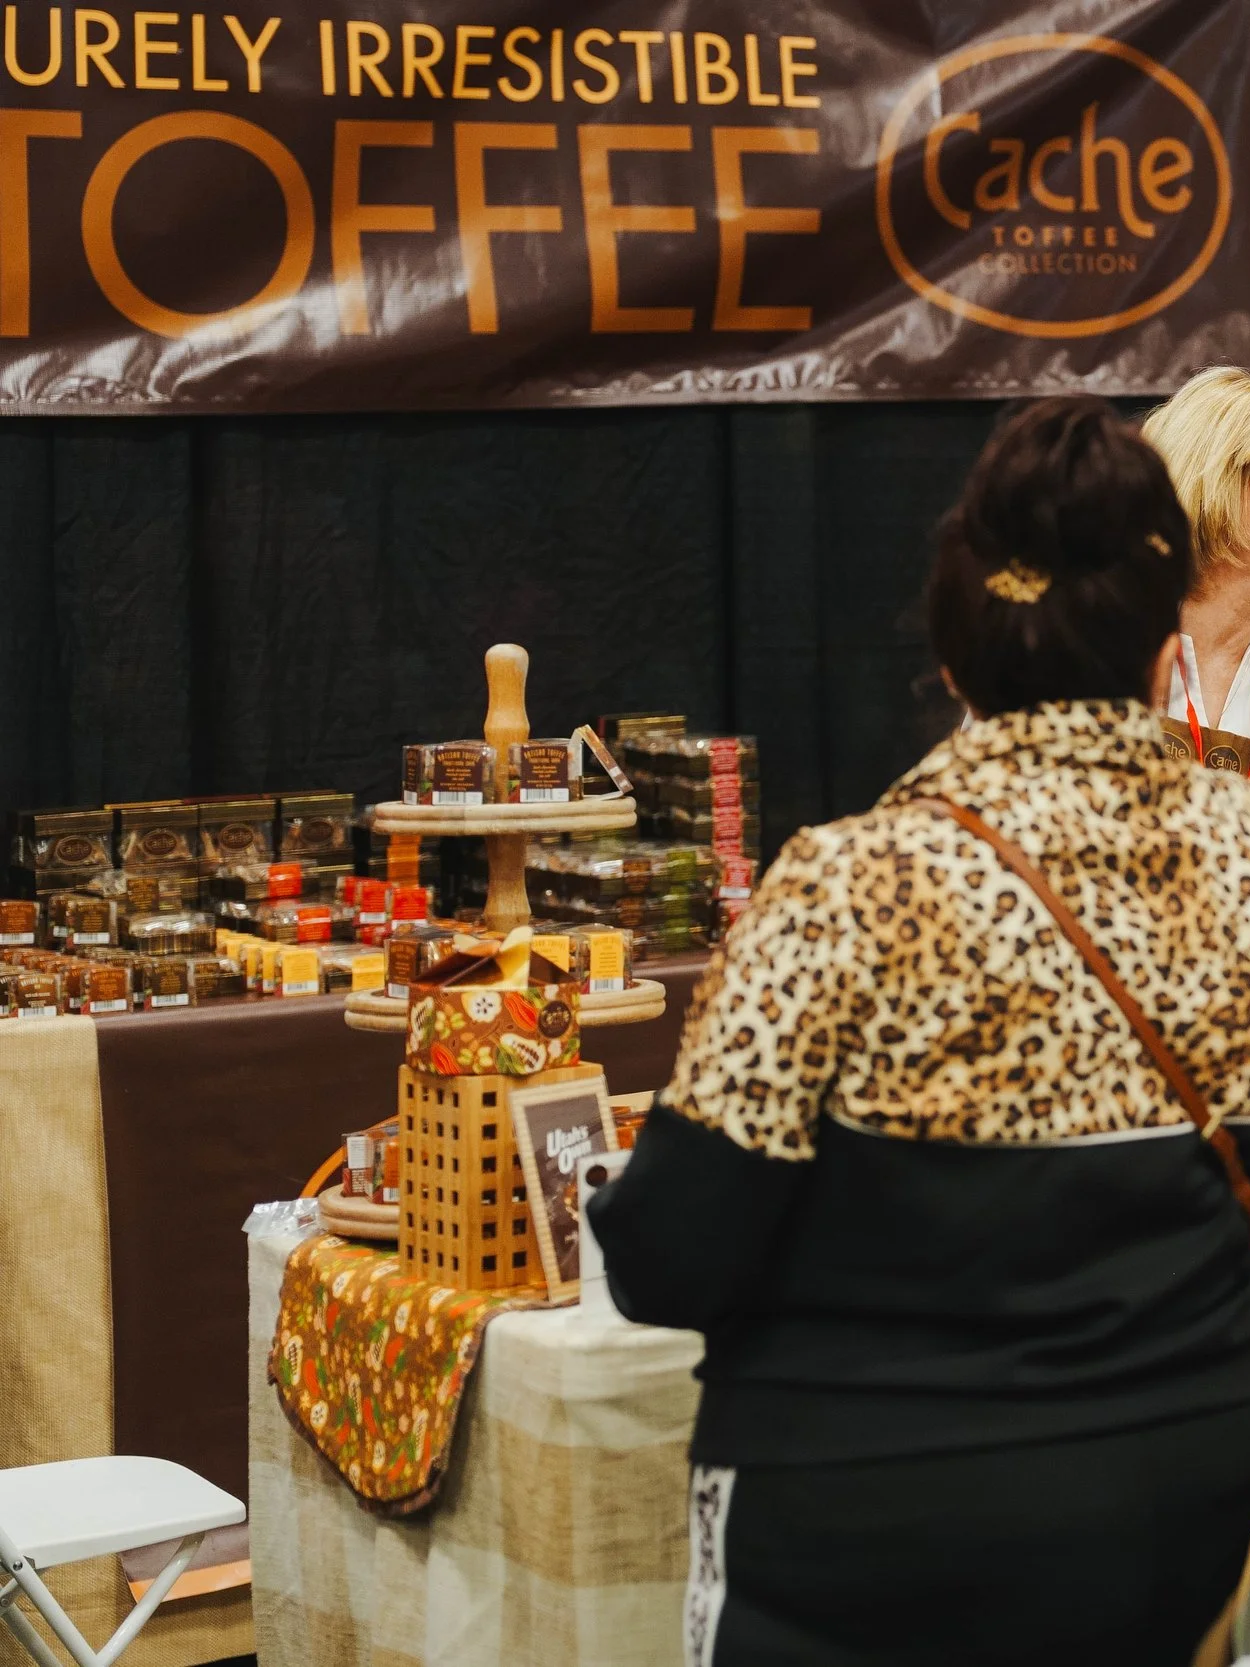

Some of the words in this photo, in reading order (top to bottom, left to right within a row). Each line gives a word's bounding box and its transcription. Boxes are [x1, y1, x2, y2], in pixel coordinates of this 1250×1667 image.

[4, 4, 281, 93] URELY
[319, 19, 821, 109] IRRESISTIBLE
[923, 101, 1194, 239] Cache
[0, 108, 822, 340] TOFFEE
[977, 252, 1138, 276] COLLECTION
[993, 226, 1119, 247] TOFFEE
